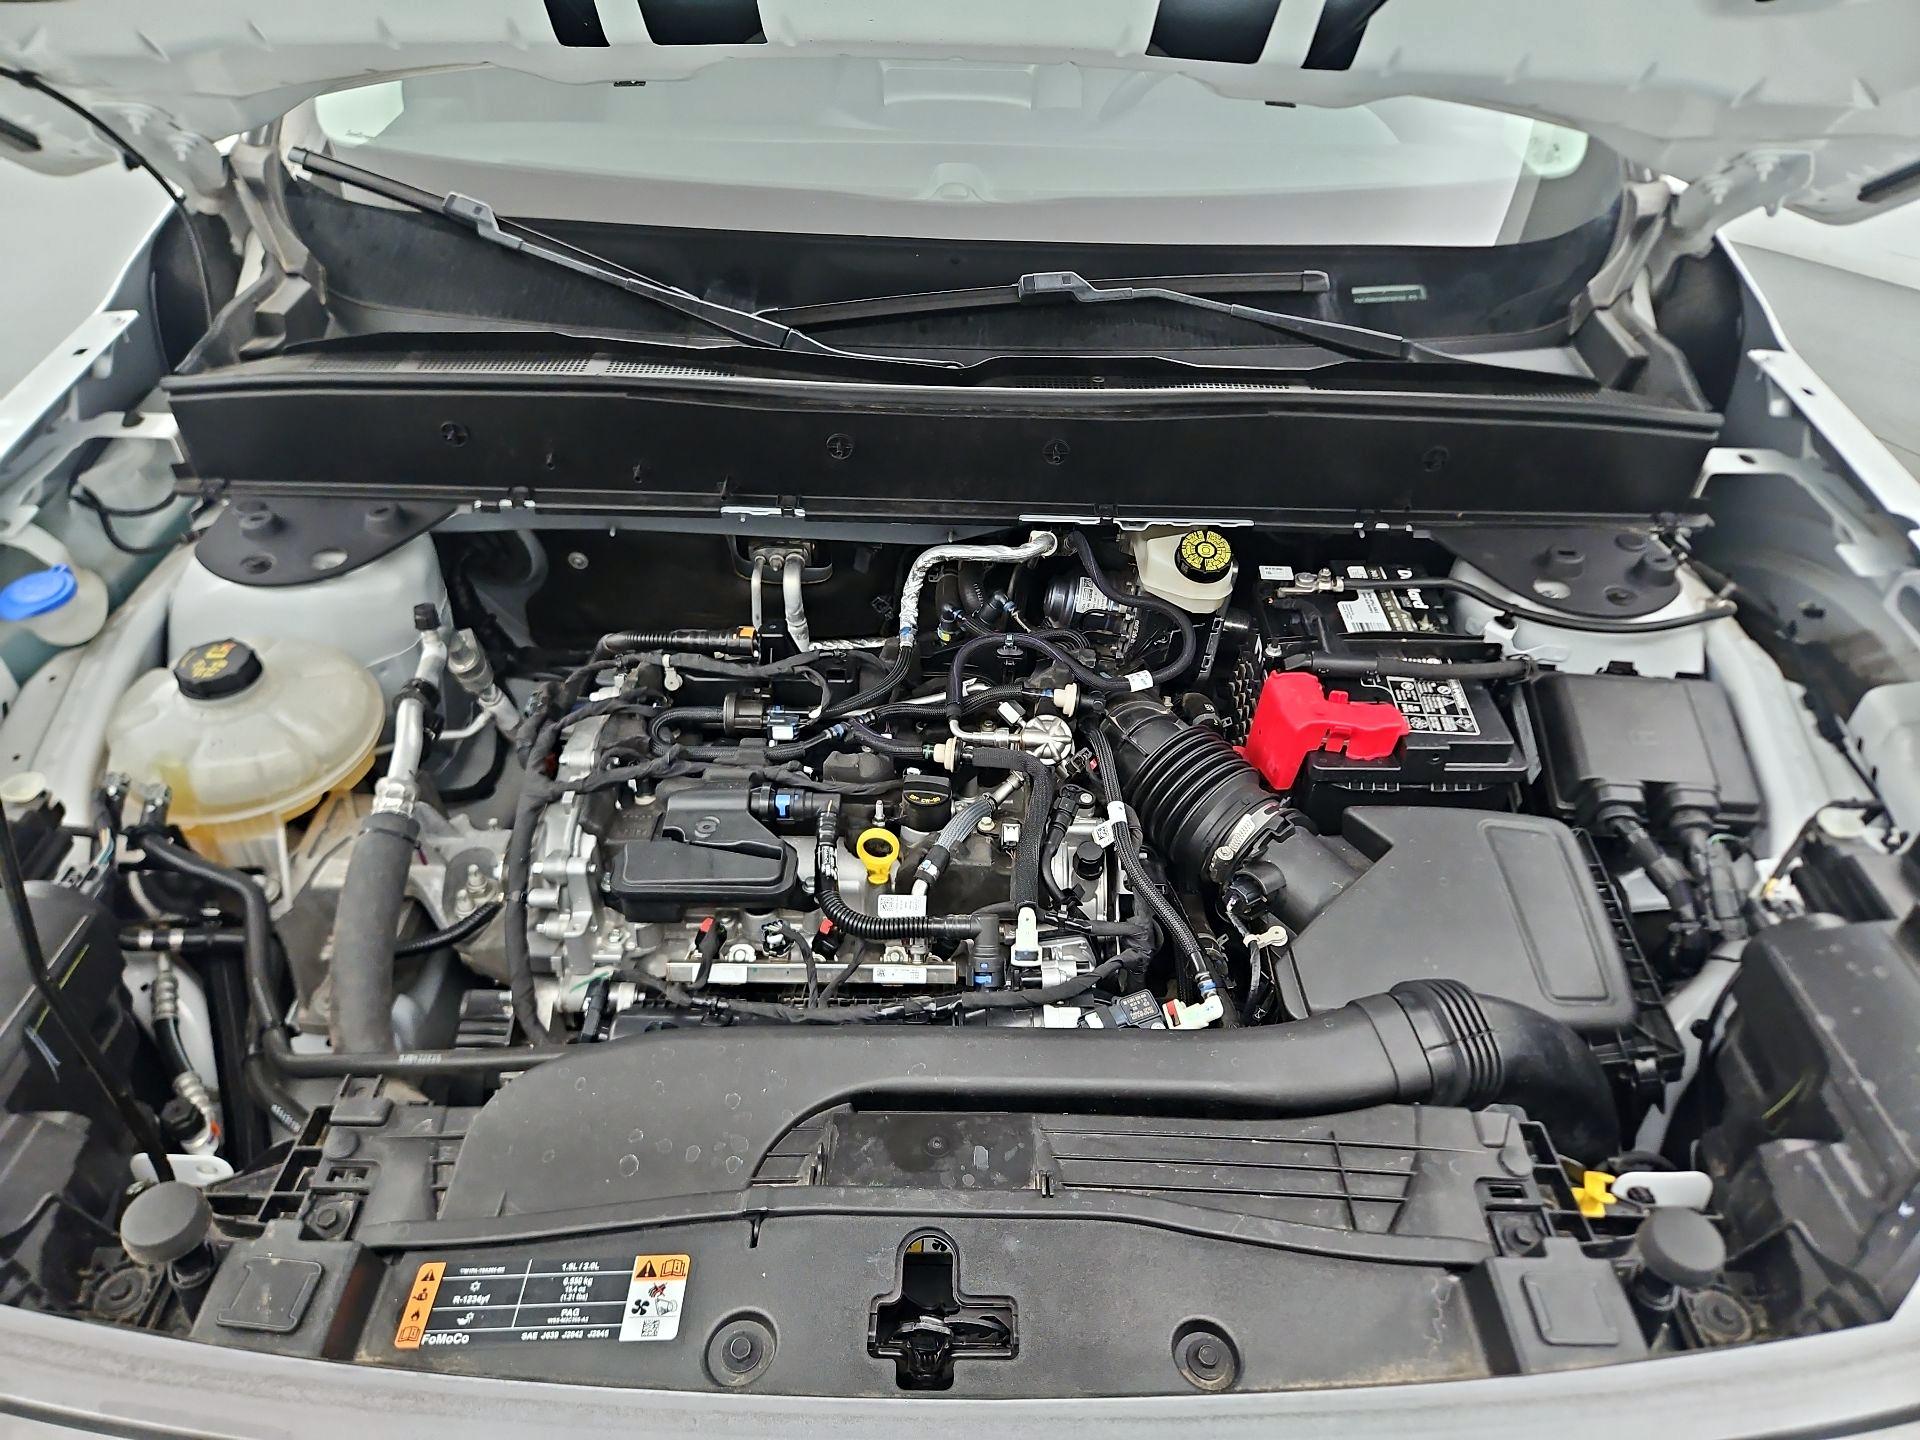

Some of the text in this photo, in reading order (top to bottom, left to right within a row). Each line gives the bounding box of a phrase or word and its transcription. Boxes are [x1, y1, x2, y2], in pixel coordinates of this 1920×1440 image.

[452, 1294, 491, 1305] R-1234yf
[421, 1333, 470, 1345] FoMoCo
[521, 1332, 538, 1340] SAE
